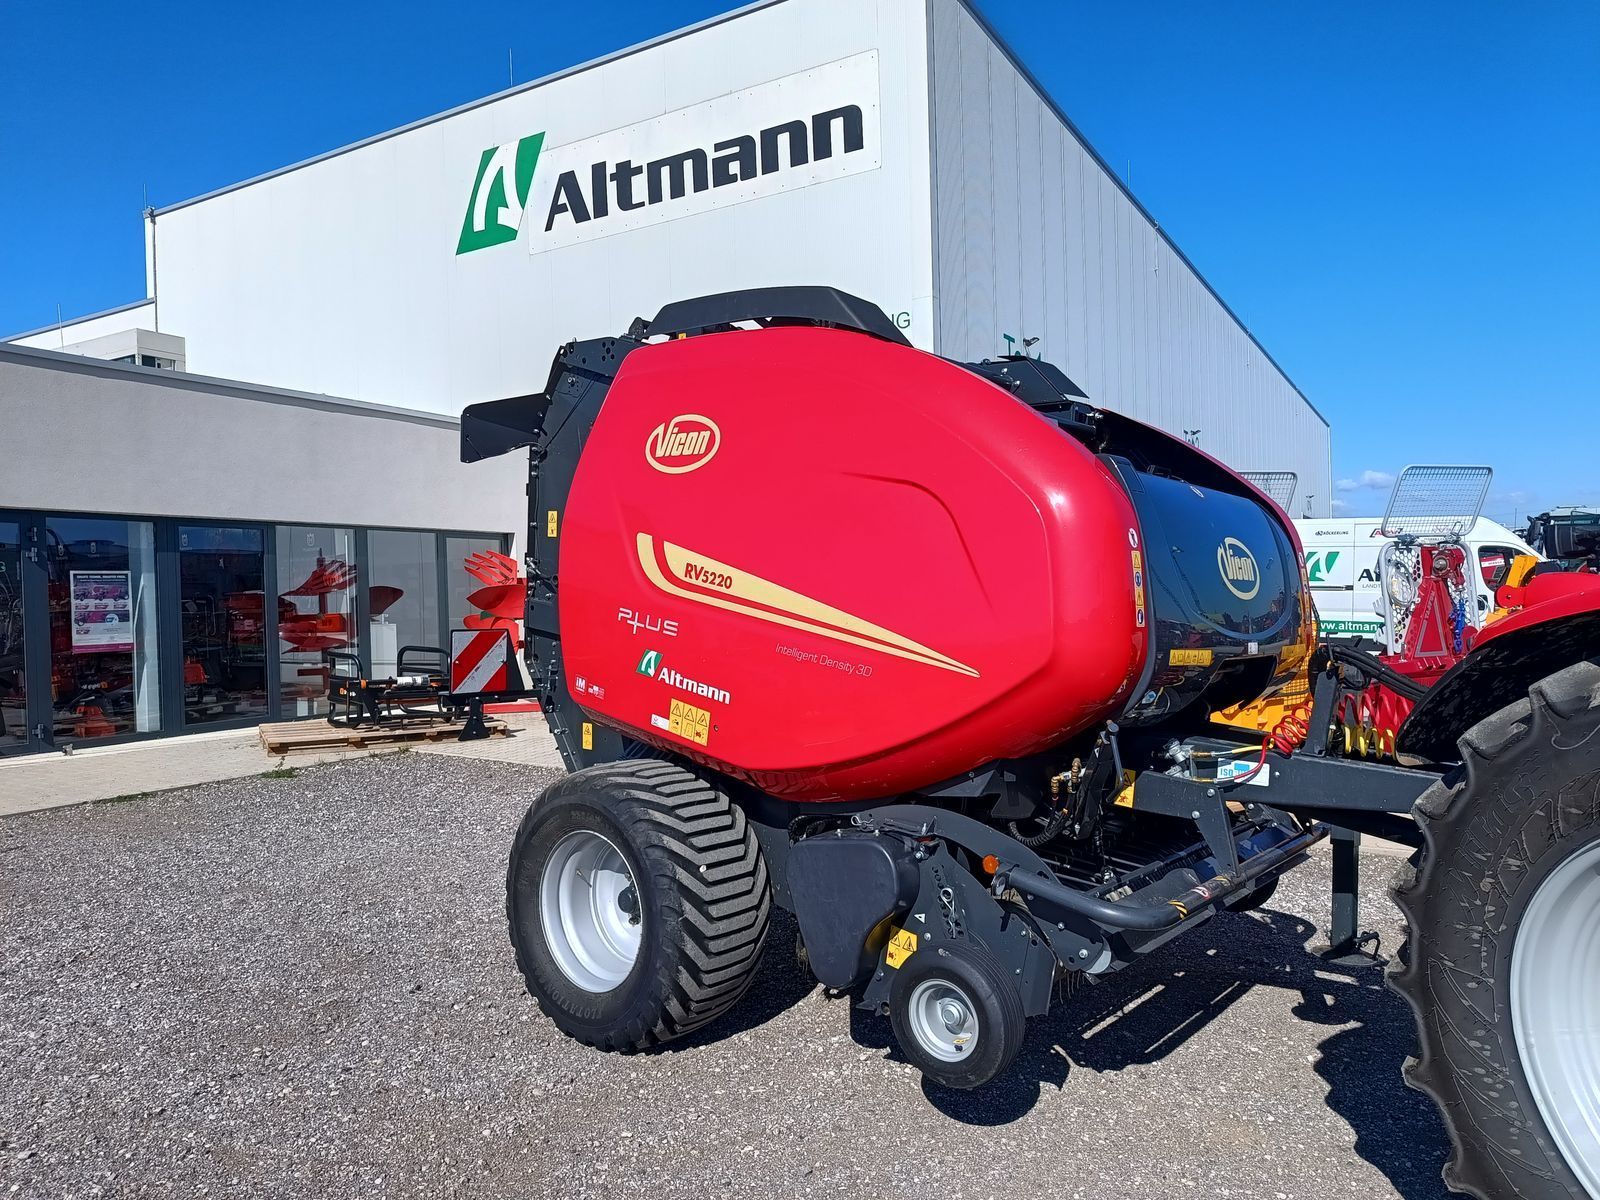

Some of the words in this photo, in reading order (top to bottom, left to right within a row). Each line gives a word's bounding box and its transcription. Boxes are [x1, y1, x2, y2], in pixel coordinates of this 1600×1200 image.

[544, 104, 865, 232] Altmann
[653, 417, 713, 459] Vicon
[684, 562, 733, 590] RV5220
[1219, 541, 1255, 582] Vicon
[775, 643, 818, 662] Intelligent
[819, 654, 855, 675] Density
[856, 664, 873, 677] 3D
[658, 667, 731, 705] Altmann
